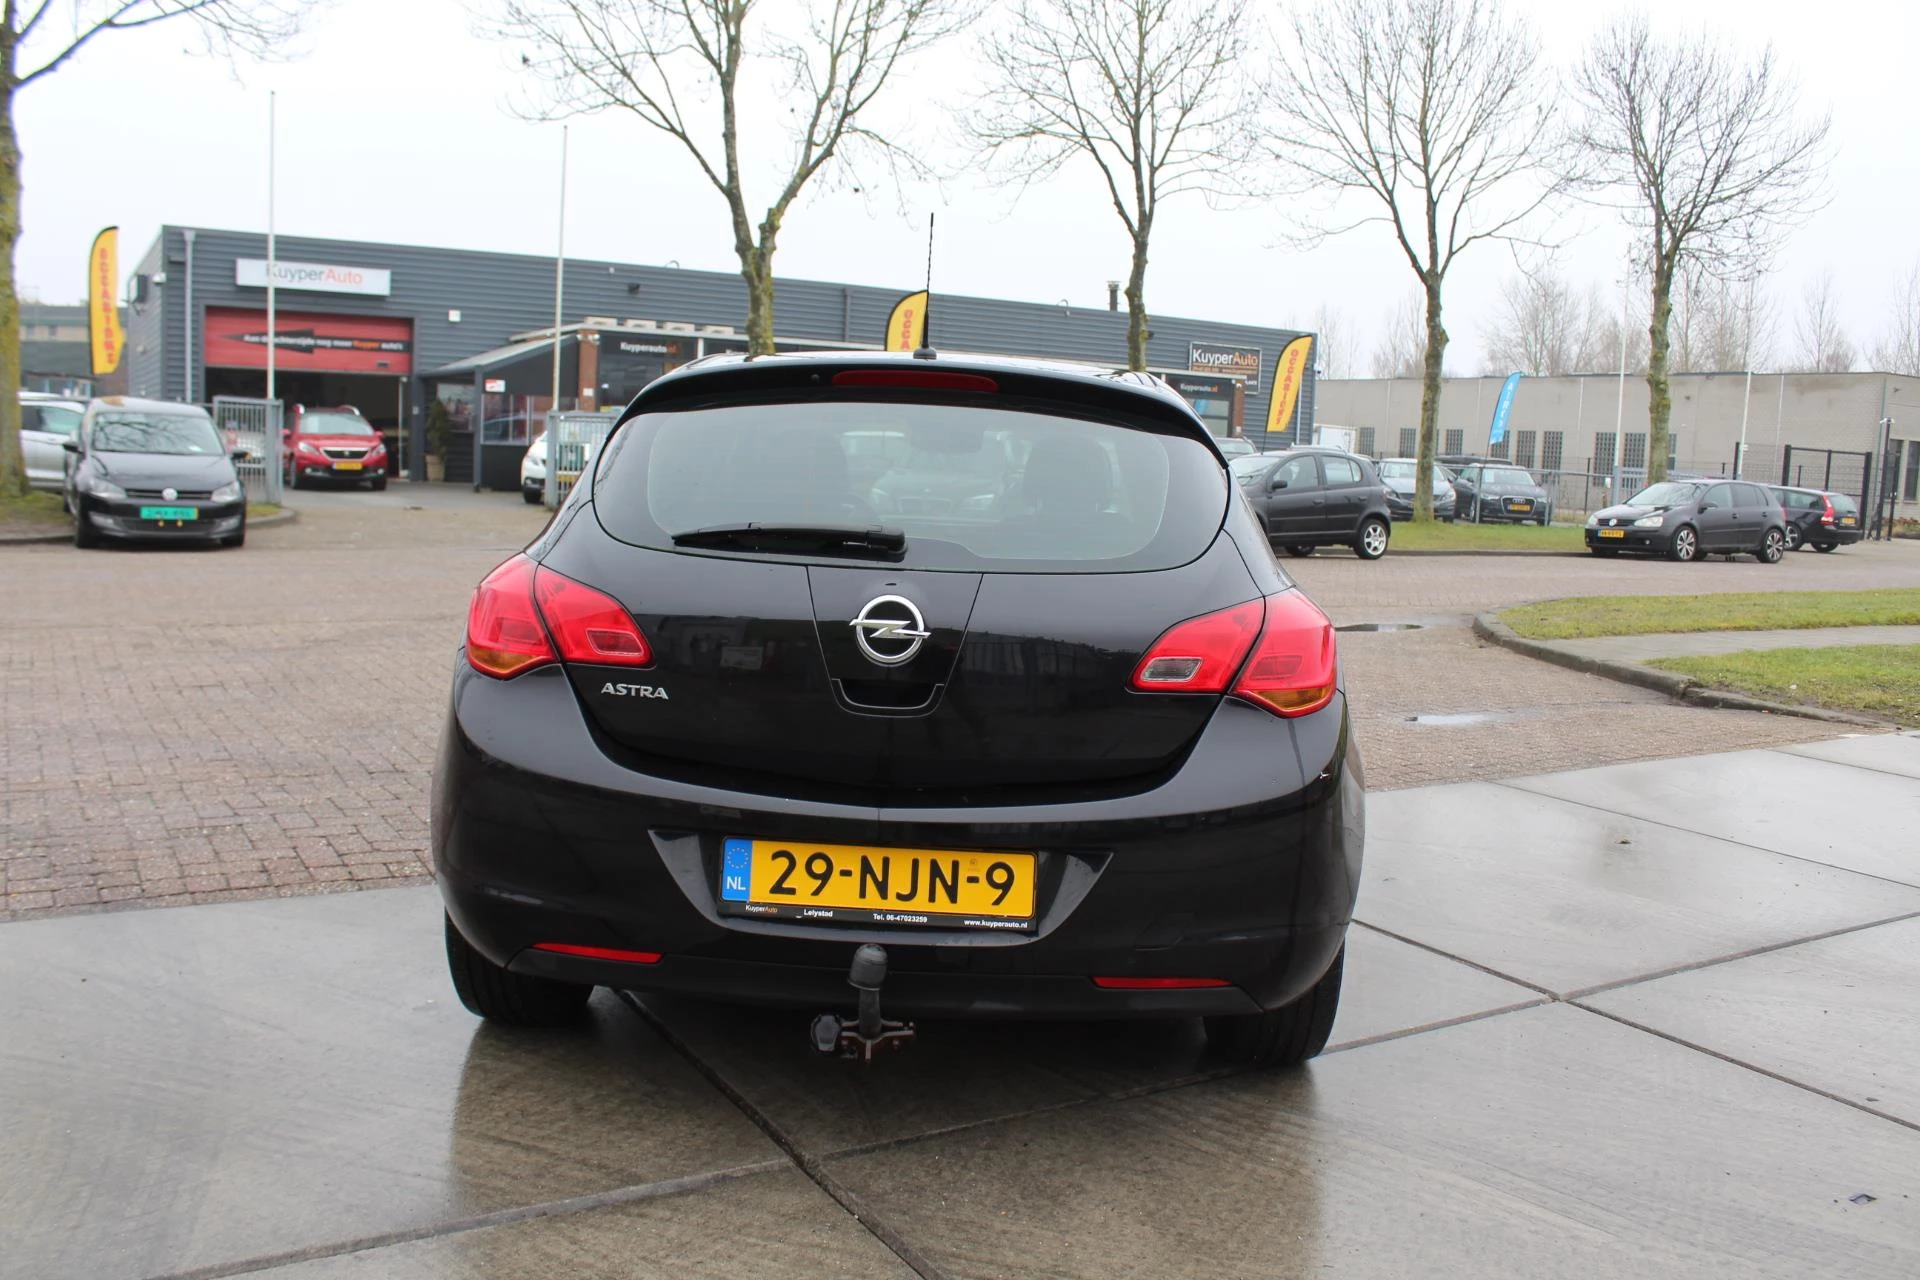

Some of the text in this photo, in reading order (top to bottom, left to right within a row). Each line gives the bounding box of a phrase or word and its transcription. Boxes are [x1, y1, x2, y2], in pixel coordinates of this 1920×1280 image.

[265, 262, 363, 286] KuyperAuto
[1192, 349, 1258, 366] KuyperAuto
[600, 682, 669, 700] ASTRA
[726, 849, 1015, 906] NL 29-NJN-9
[745, 904, 778, 913] KuyperAuto
[803, 908, 833, 918] Lelystad
[872, 913, 885, 921] Tel.
[964, 919, 1028, 929] www.kuyperauto.nl
